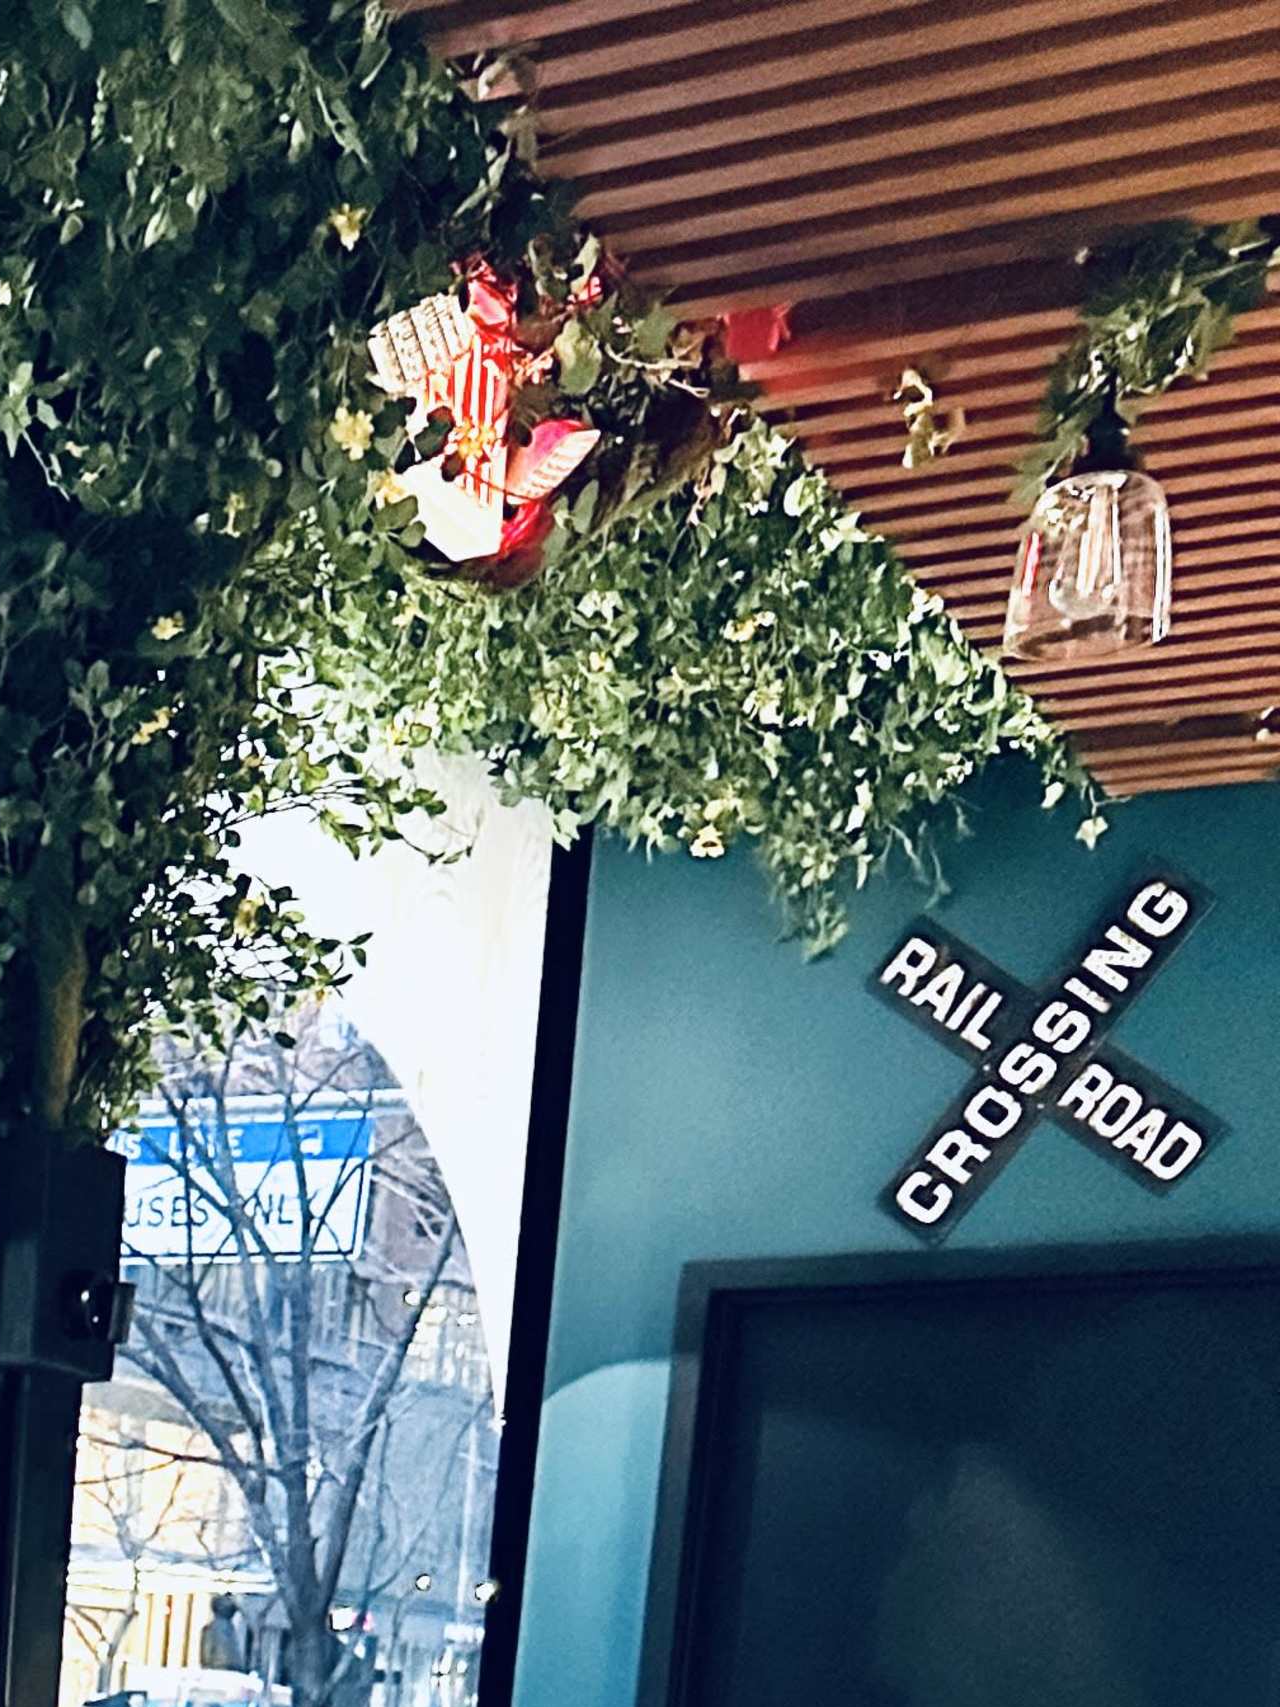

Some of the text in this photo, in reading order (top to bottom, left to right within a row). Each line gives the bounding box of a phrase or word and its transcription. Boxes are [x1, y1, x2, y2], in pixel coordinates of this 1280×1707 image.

[880, 937, 1202, 1180] RAIL ROAD
[896, 882, 1188, 1224] CROSSING
[124, 1195, 209, 1227] USES
